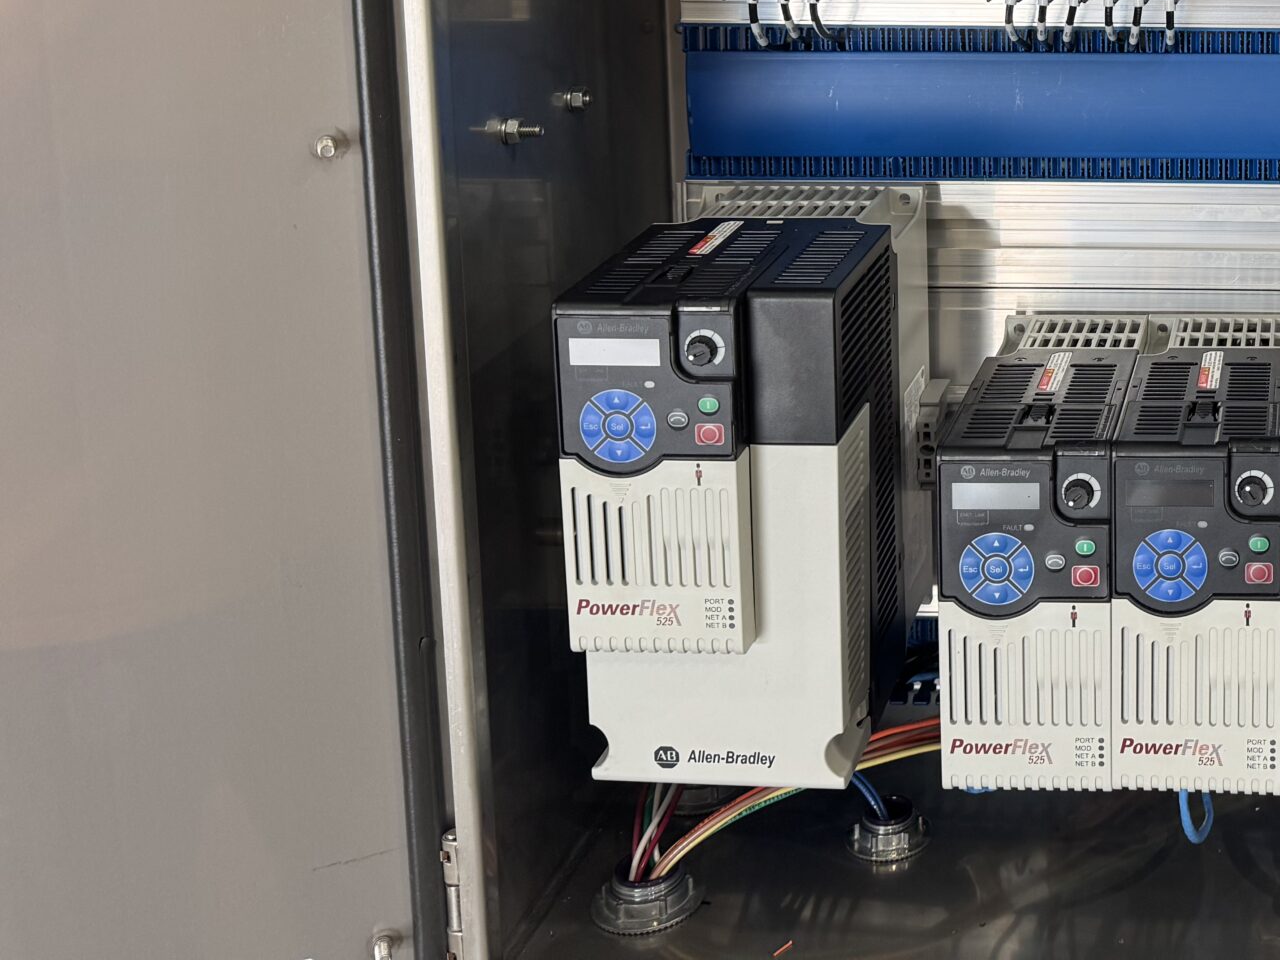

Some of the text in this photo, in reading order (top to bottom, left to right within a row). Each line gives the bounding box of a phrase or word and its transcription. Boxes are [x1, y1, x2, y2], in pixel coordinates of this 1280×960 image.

[597, 323, 649, 334] Allen-Bradley
[583, 422, 599, 431] Esc
[611, 422, 624, 431] Sel
[980, 468, 1031, 479] Allen-Bradley
[1154, 464, 1205, 475] Allen-Bradley
[963, 565, 978, 574] Esc
[990, 565, 1003, 573] Sel
[1136, 562, 1151, 571] Esc
[1163, 561, 1176, 570] Sel
[576, 598, 682, 626] PowerFlex
[656, 616, 674, 626] 525
[950, 738, 1053, 765] PowerFlex
[1120, 737, 1223, 766] PowerFlex
[687, 750, 776, 768] Allen-Bradley
[1028, 756, 1046, 765] 525
[1197, 756, 1215, 766] 525
